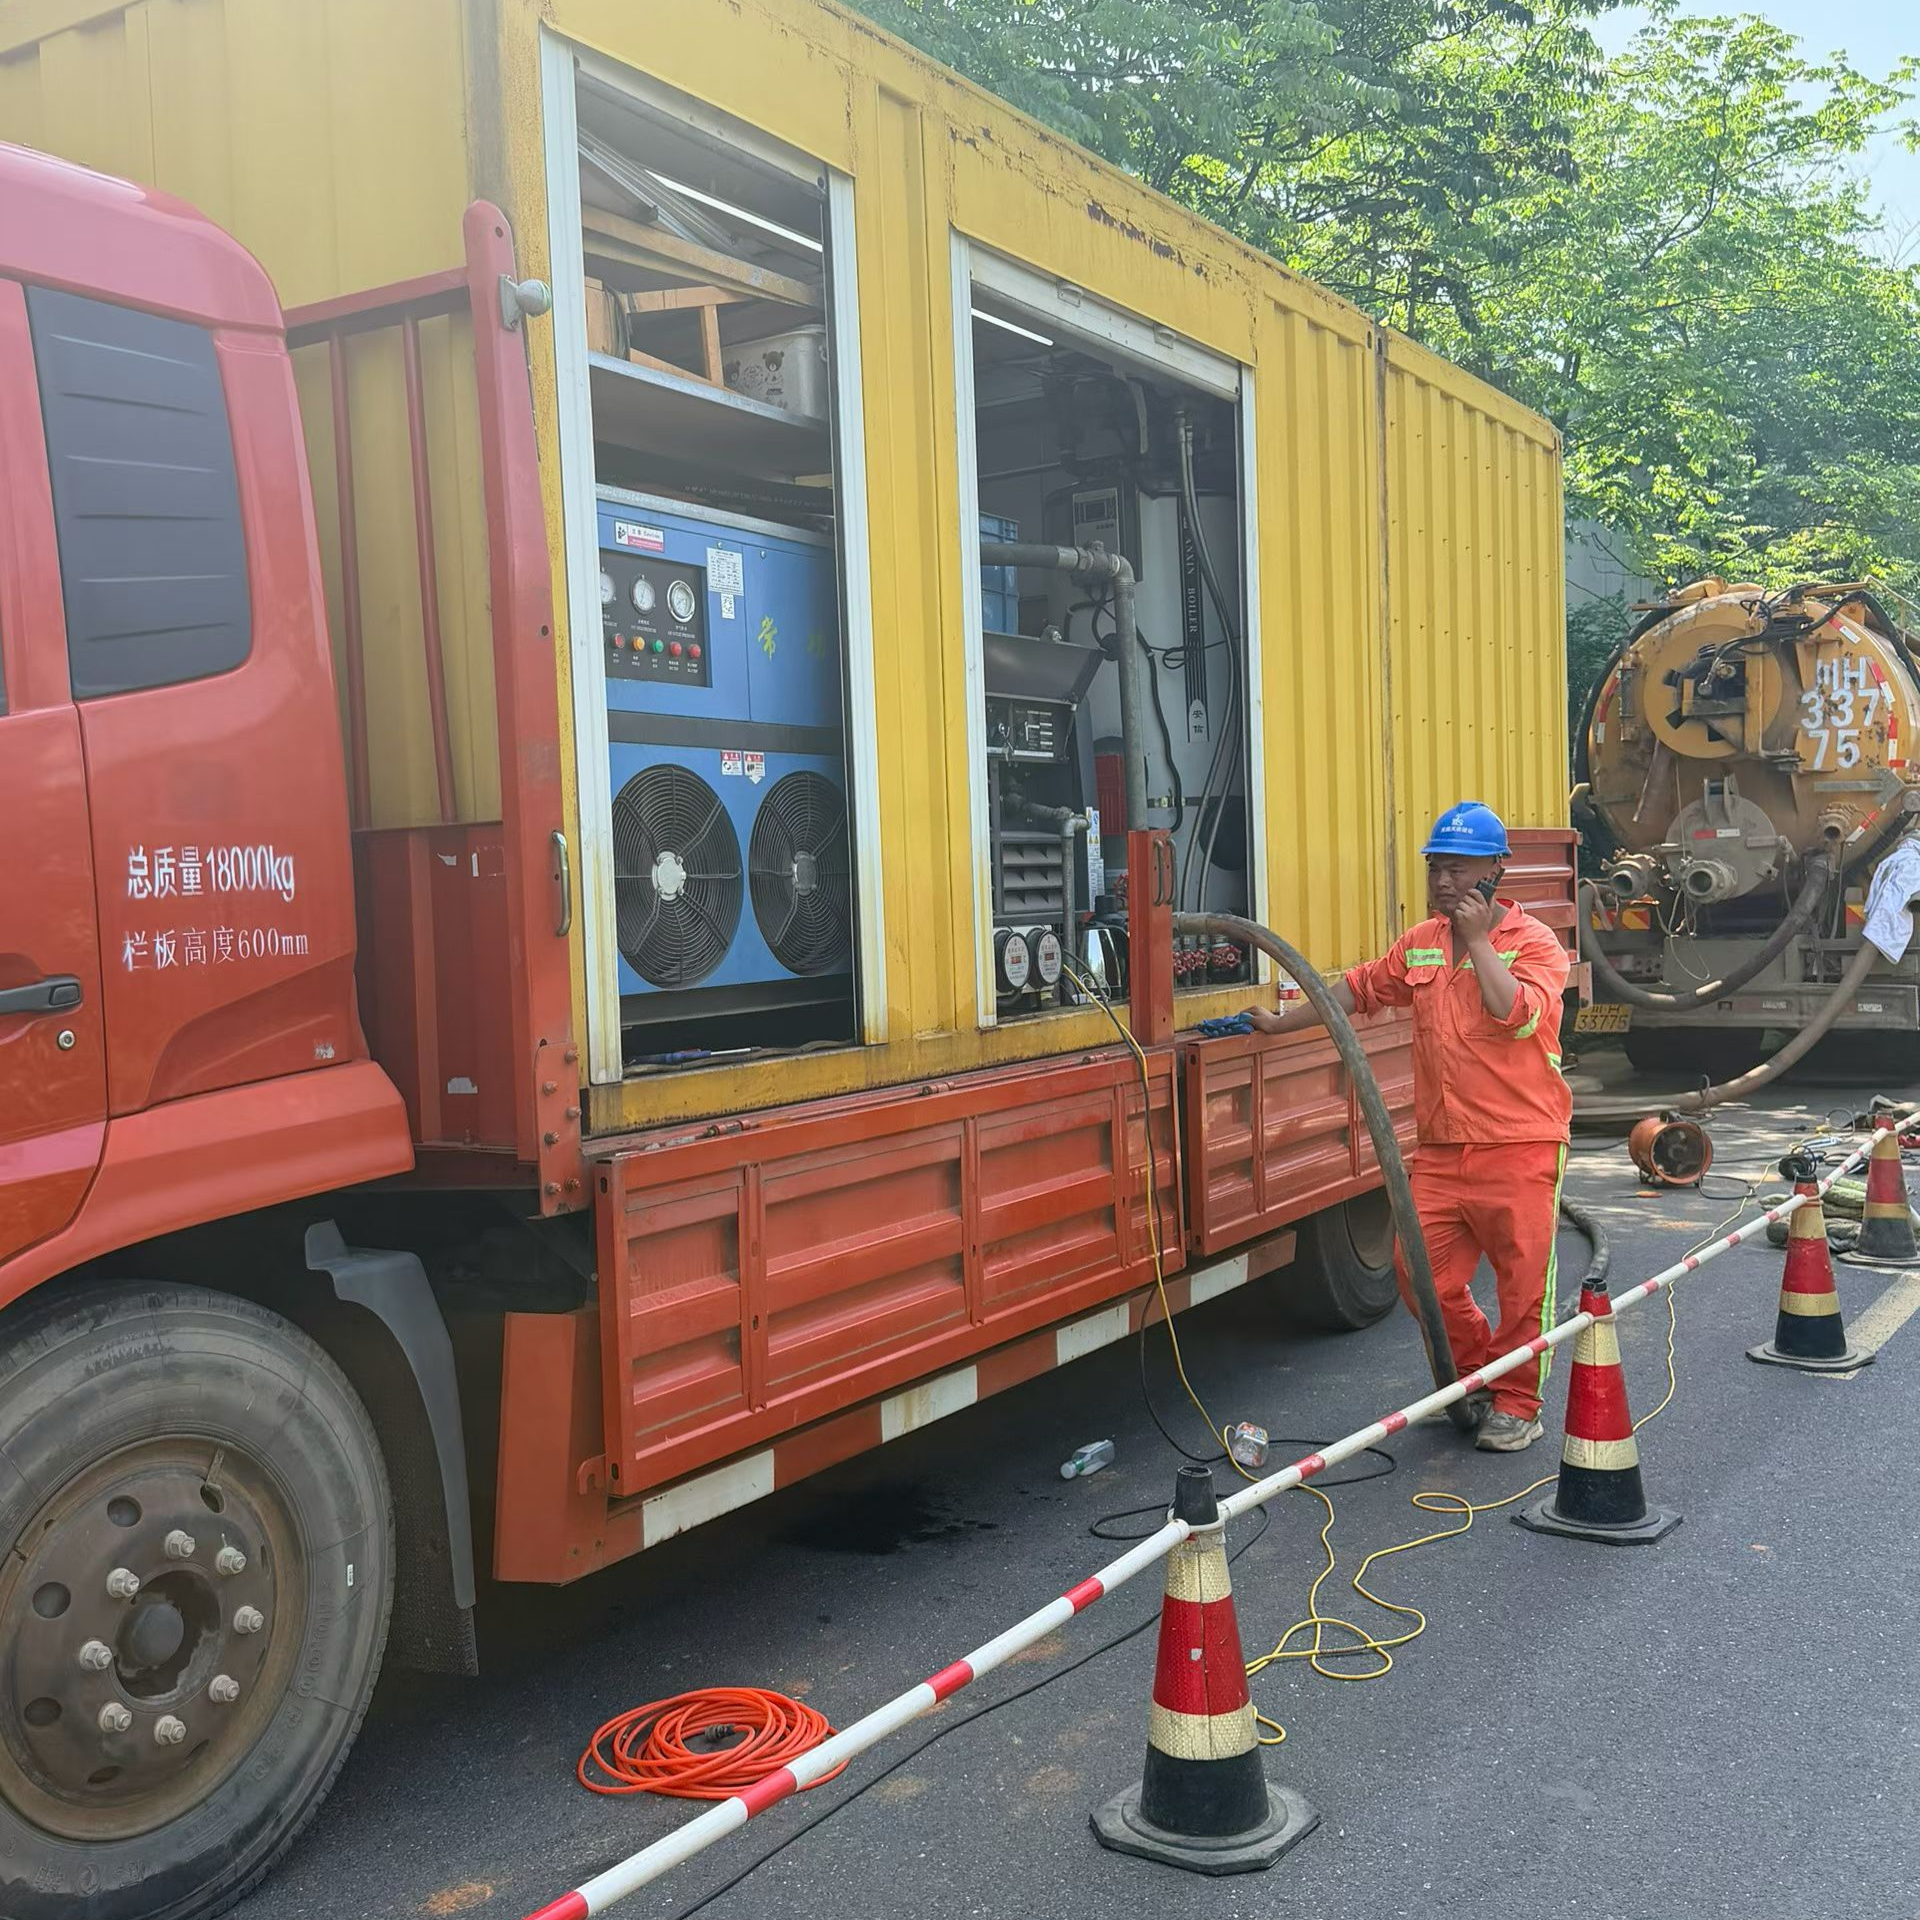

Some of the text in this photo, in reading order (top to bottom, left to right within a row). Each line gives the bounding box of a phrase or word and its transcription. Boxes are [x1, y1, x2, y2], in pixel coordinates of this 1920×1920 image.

[1187, 587, 1198, 633] BOILER
[1800, 688, 1880, 730] 337
[1807, 729, 1861, 770] 75
[127, 844, 296, 903] 总质量18000kg
[121, 925, 310, 972] 栏板高度600mm
[1577, 1014, 1629, 1030] 33775
